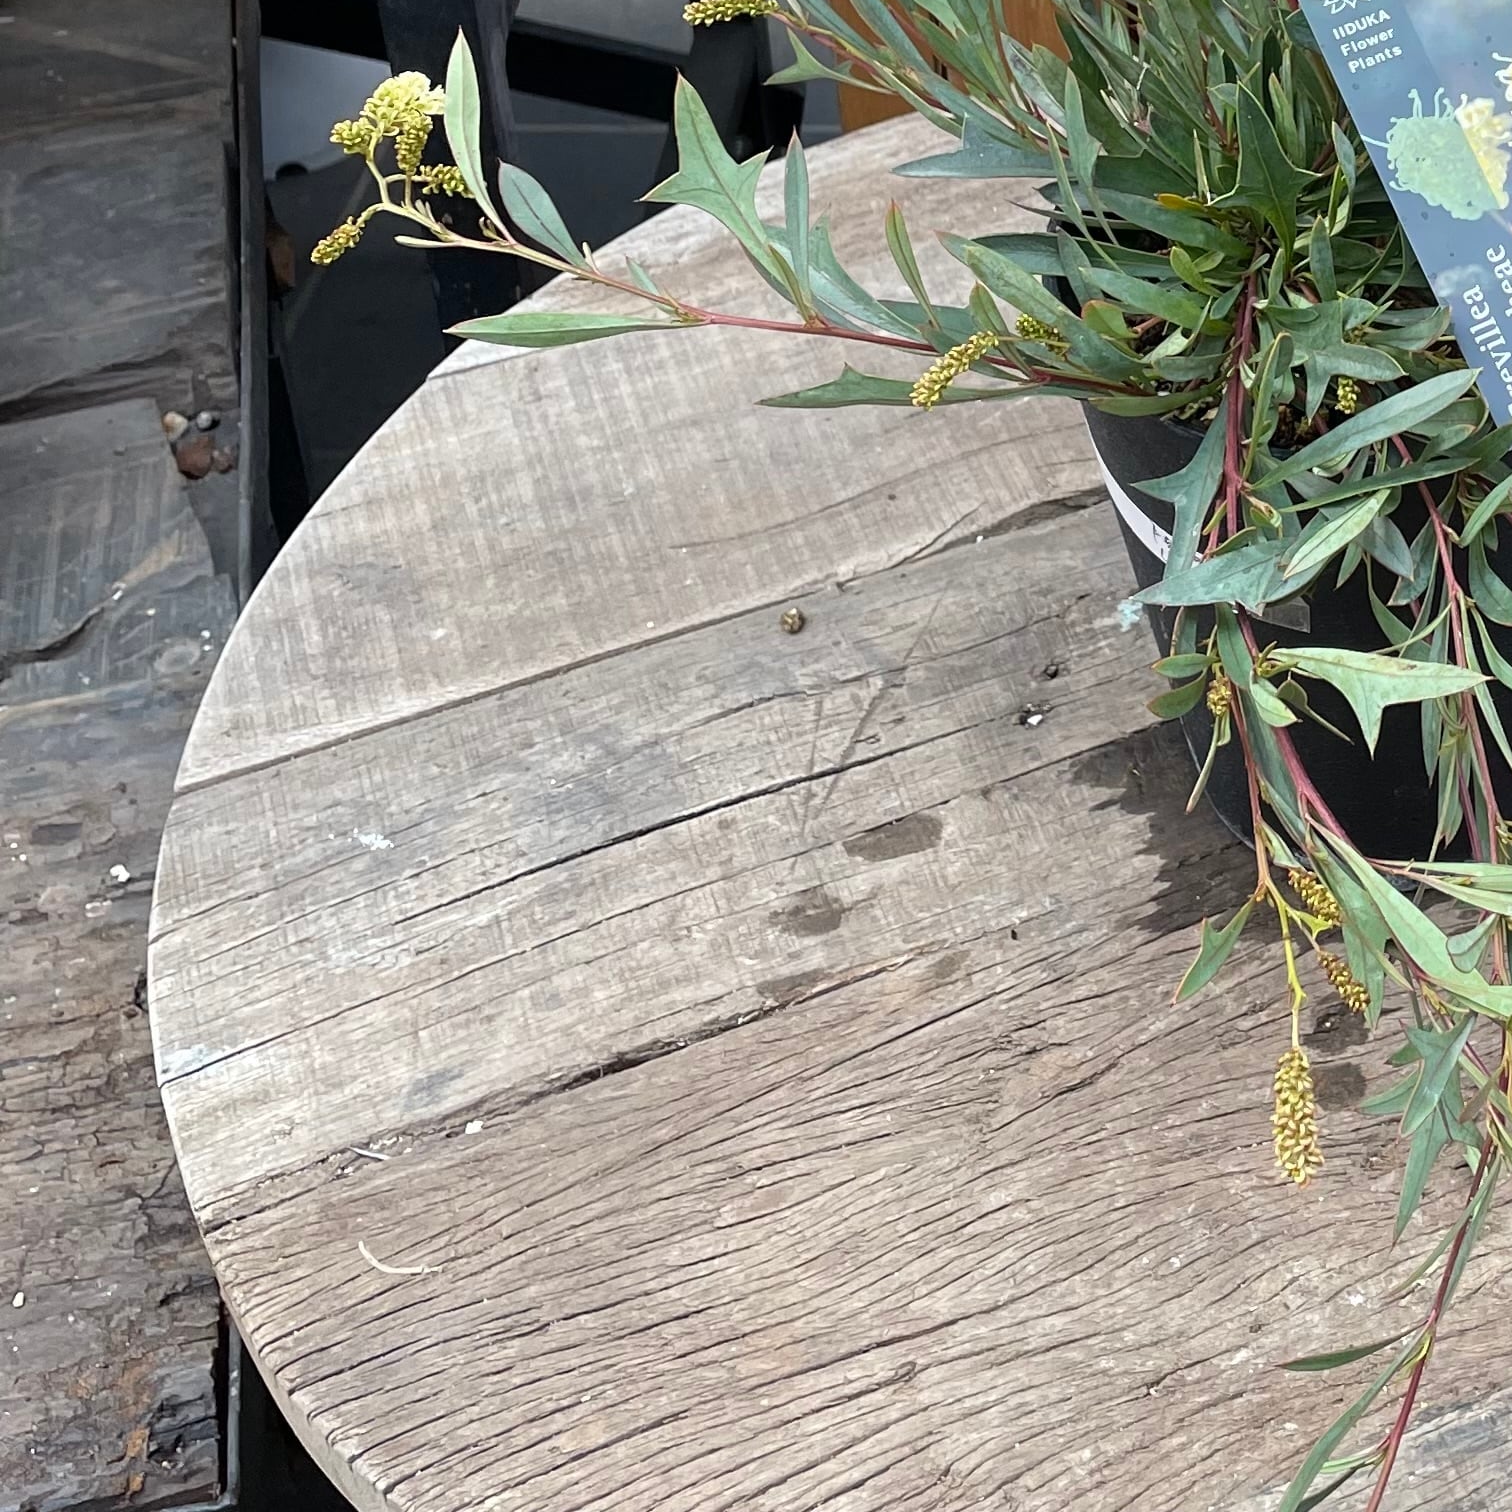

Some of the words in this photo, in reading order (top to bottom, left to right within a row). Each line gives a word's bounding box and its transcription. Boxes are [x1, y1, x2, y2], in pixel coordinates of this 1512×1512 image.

[1332, 9, 1391, 40] IIDUKA
[1340, 28, 1394, 57] Flower
[1347, 46, 1403, 74] Plants
